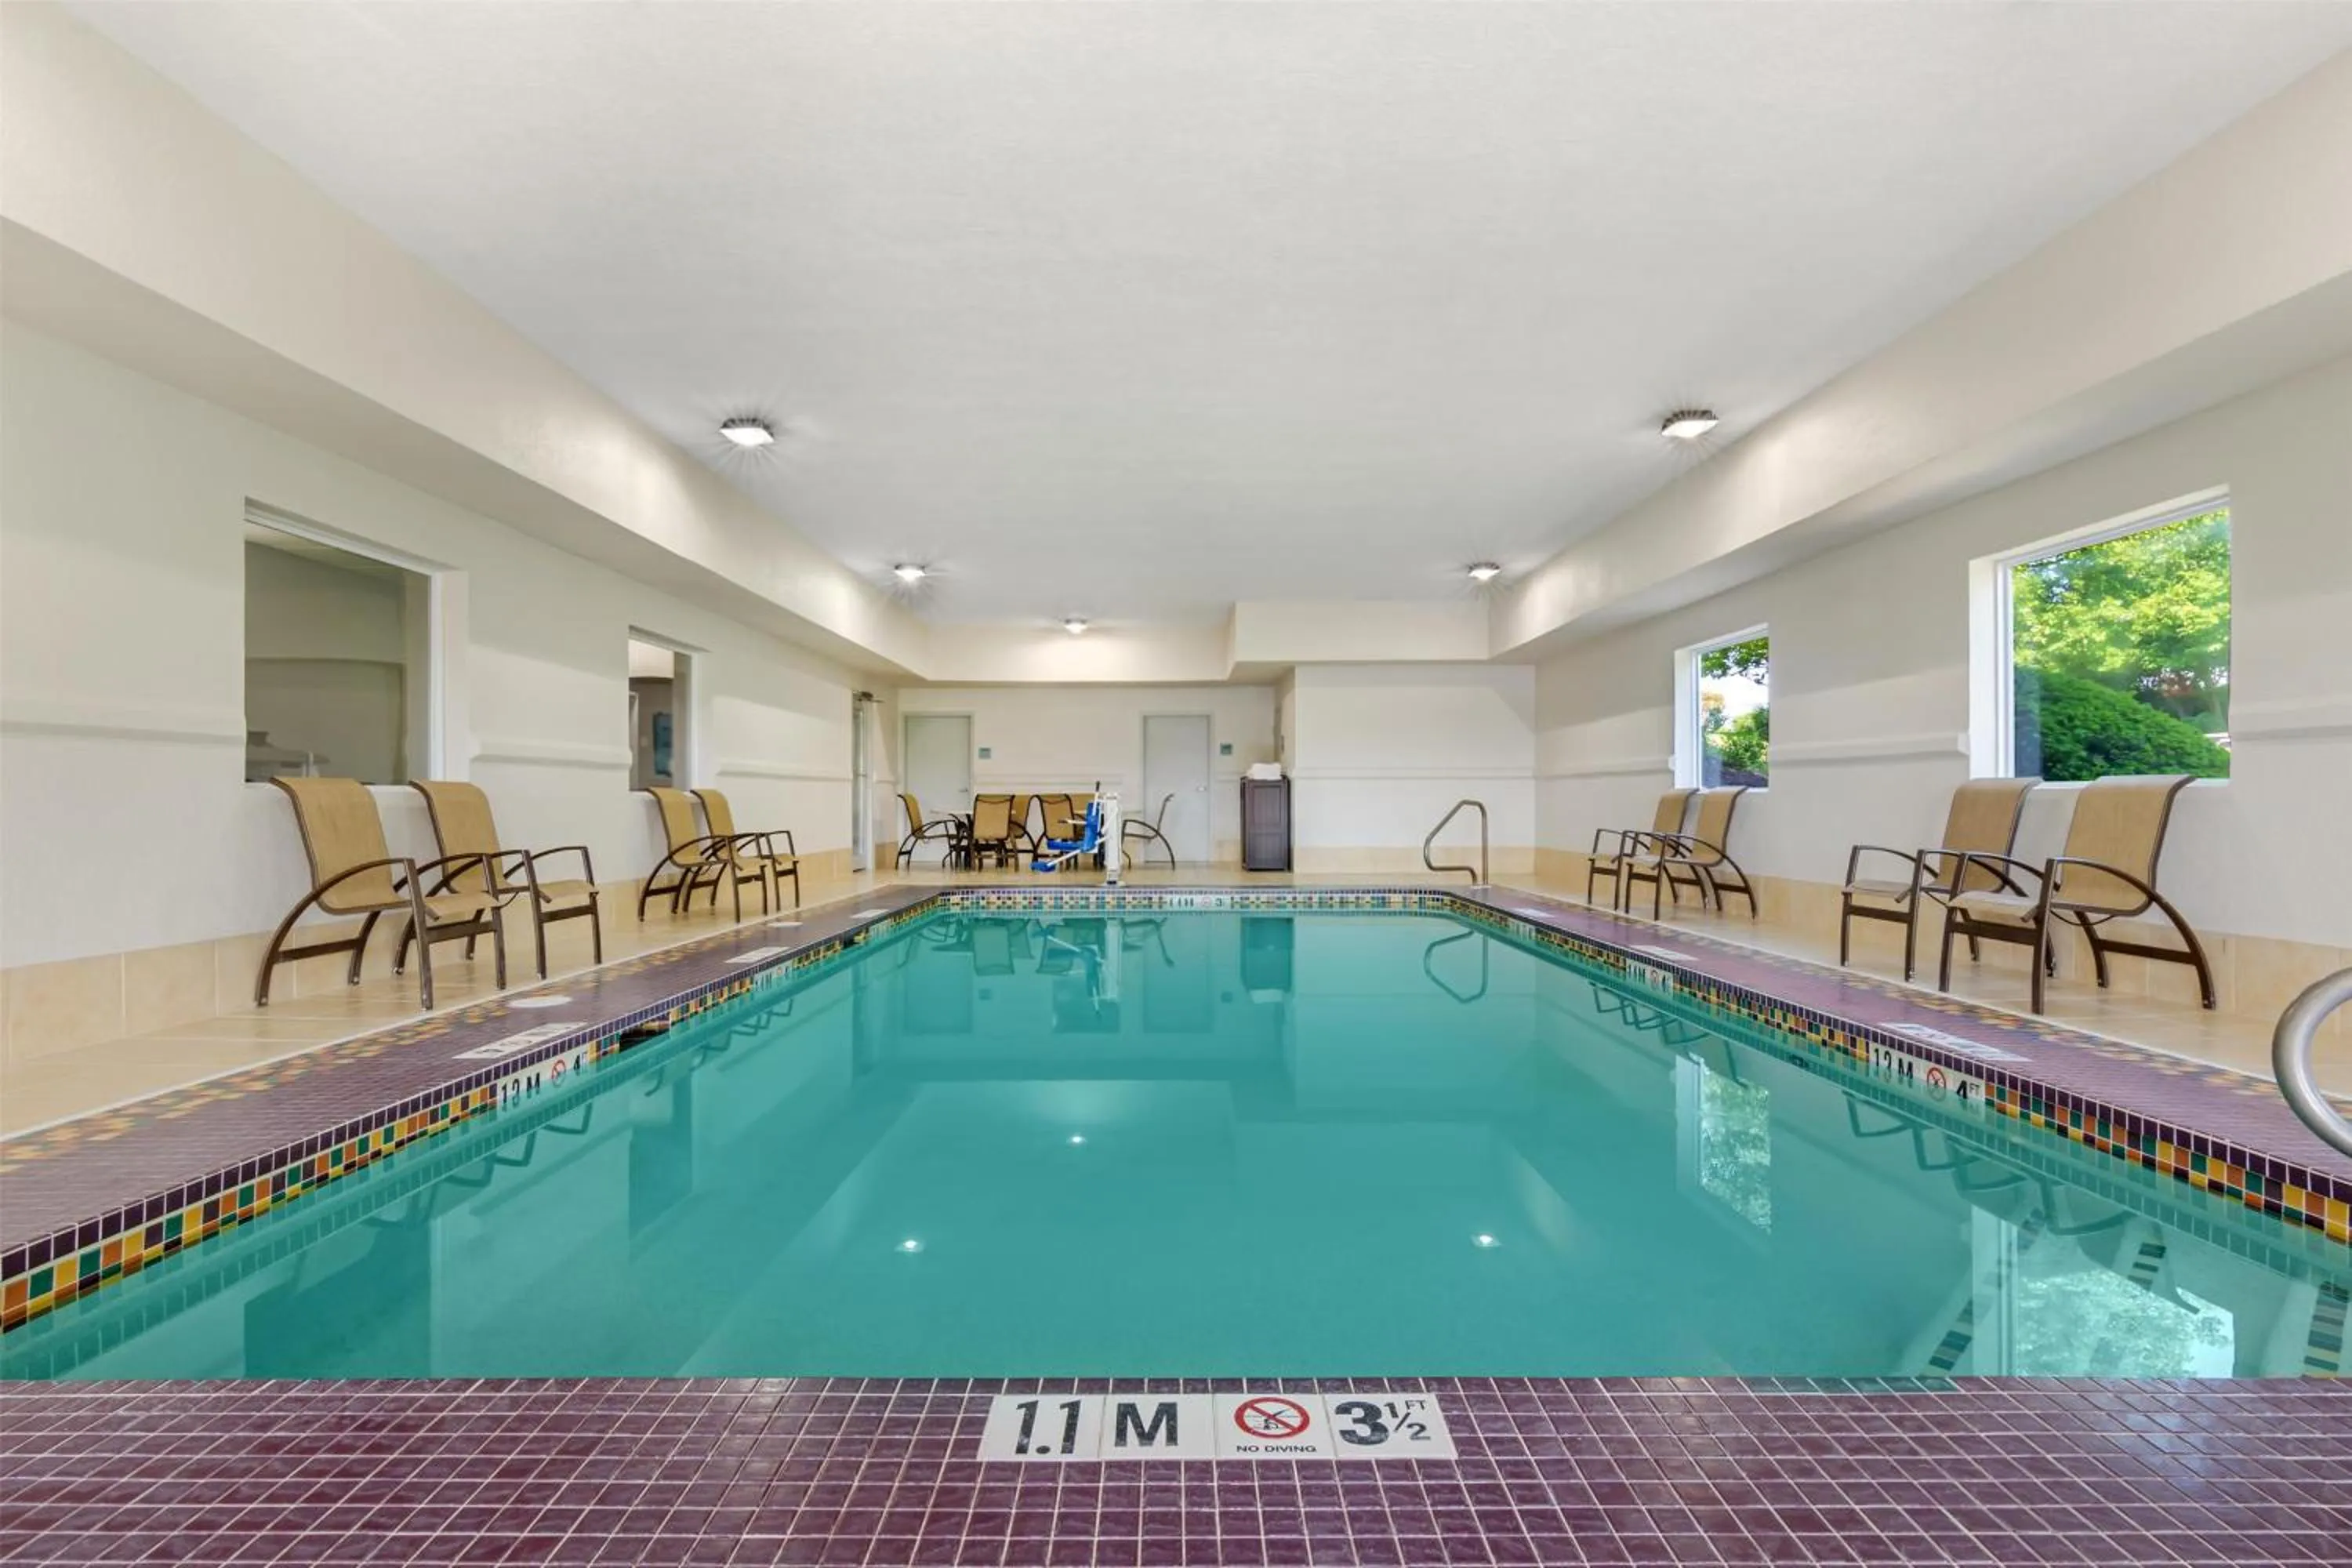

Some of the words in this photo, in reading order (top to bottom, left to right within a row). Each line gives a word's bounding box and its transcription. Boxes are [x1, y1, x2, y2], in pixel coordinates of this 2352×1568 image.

[1405, 1400, 1426, 1410] FT
[1015, 1399, 1081, 1454] 1.1
[1115, 1402, 1178, 1447] M
